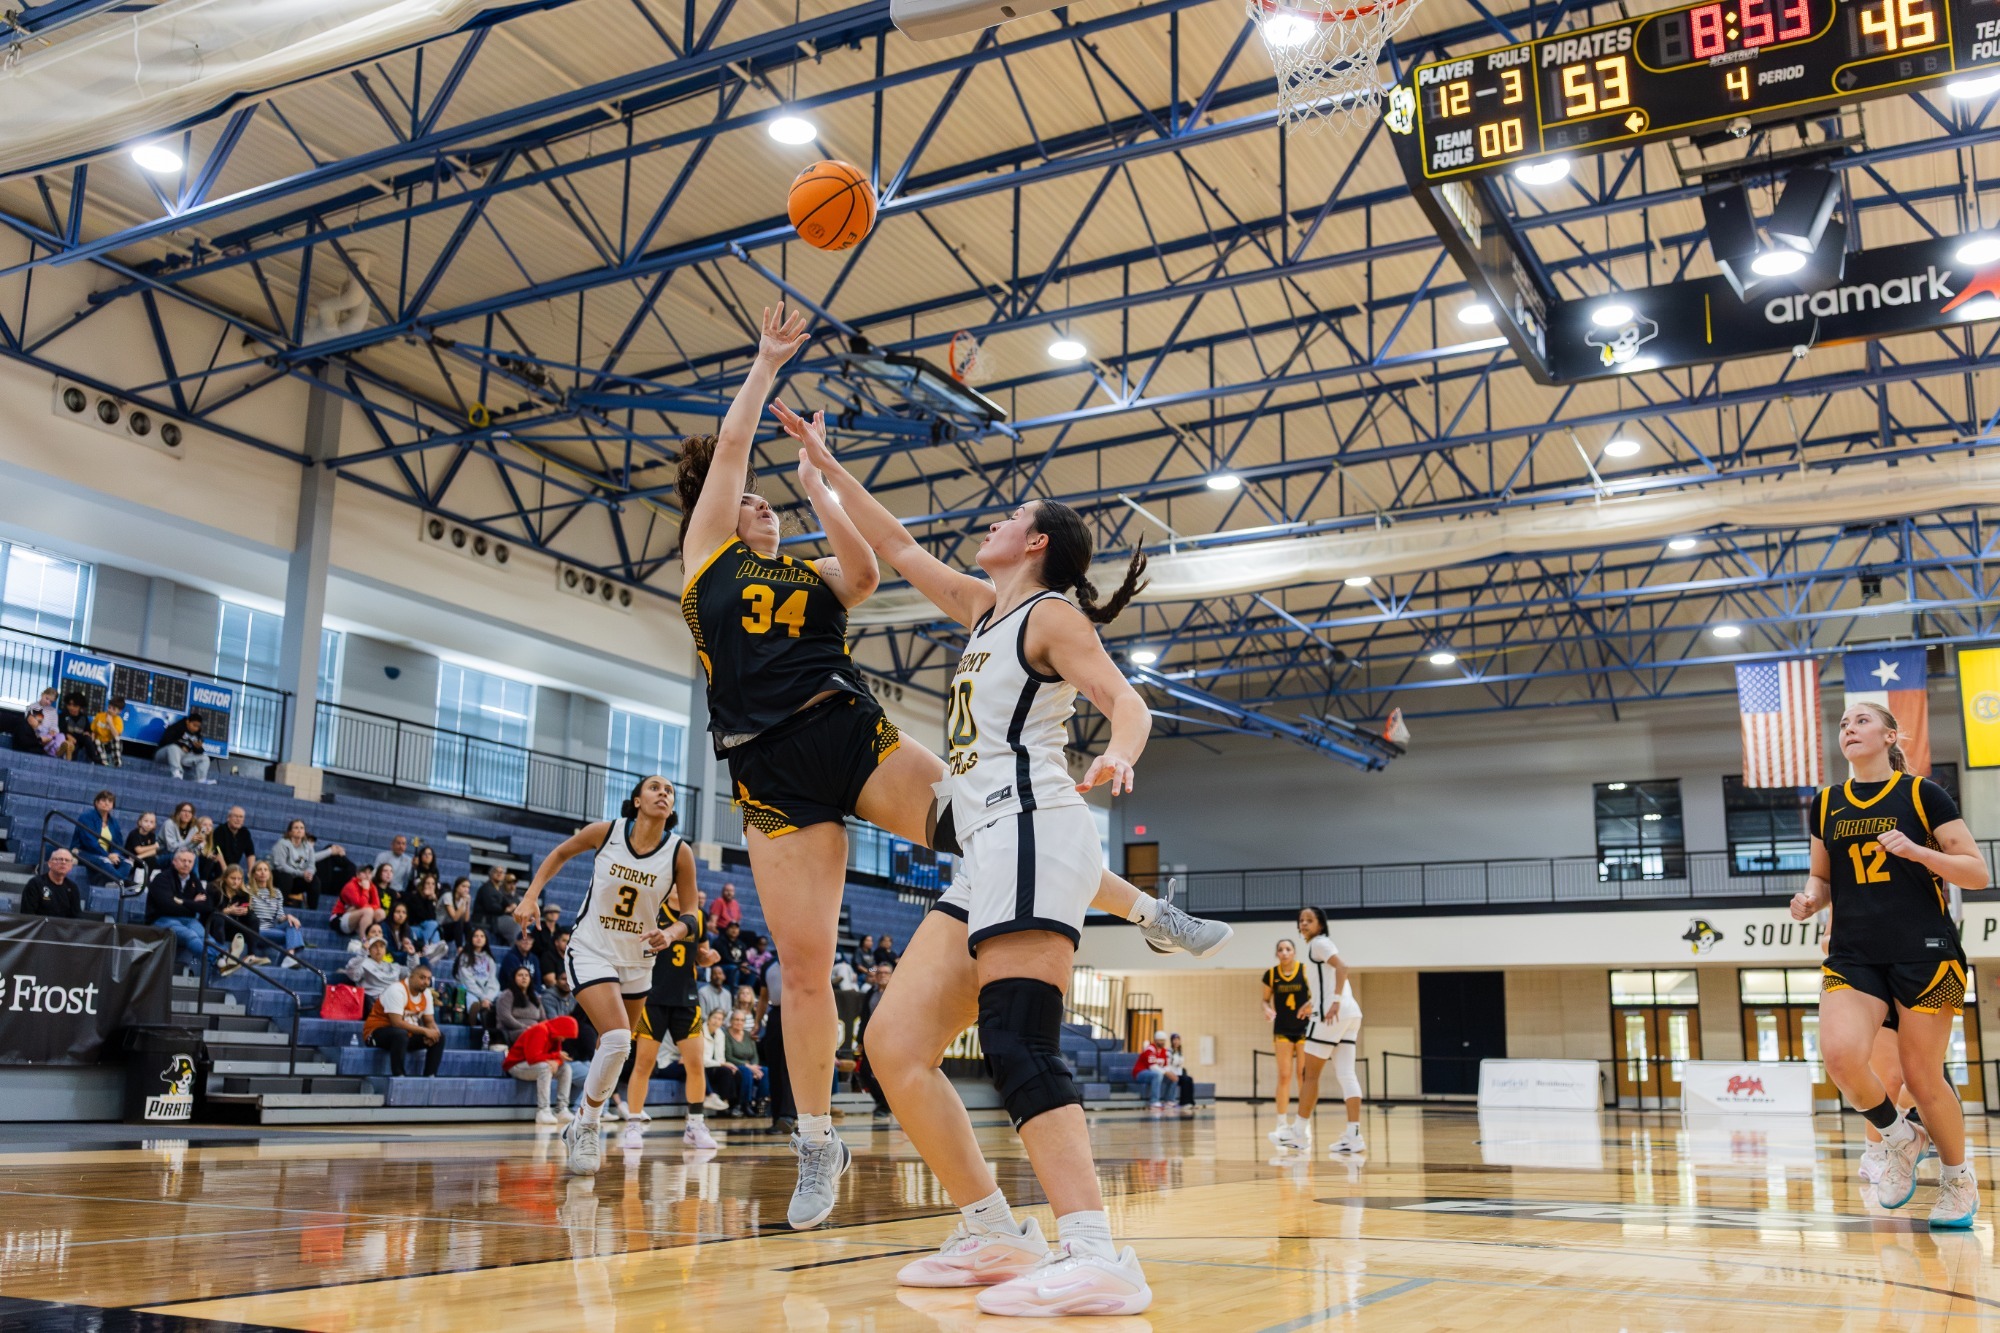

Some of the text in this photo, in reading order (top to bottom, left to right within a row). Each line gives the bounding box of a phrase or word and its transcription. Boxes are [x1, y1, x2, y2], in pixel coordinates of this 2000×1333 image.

[1861, 0, 1936, 51] 45
[1487, 47, 1531, 71] FOULS
[1541, 27, 1633, 68] PIRATES
[1419, 60, 1475, 87] PLAYER
[1562, 56, 1630, 117] 53
[1726, 66, 1749, 100] 4
[1758, 64, 1805, 87] PERIOD
[1439, 69, 1523, 118] 12 3
[1435, 129, 1473, 152] TEAM
[1479, 118, 1523, 158] 00
[1432, 146, 1475, 171] FOULS
[1764, 265, 1956, 324] aramark
[741, 583, 809, 638] 34
[67, 659, 105, 680] HOME
[193, 686, 231, 709] VISITOR
[1833, 816, 1898, 841] PIRATES
[609, 863, 658, 888] STORMY
[1848, 841, 1891, 885] 12
[613, 884, 639, 919] 3
[599, 915, 644, 935] PETRELS
[672, 943, 686, 968] 3
[8, 974, 99, 1015] Frost
[1285, 993, 1296, 1011] 4
